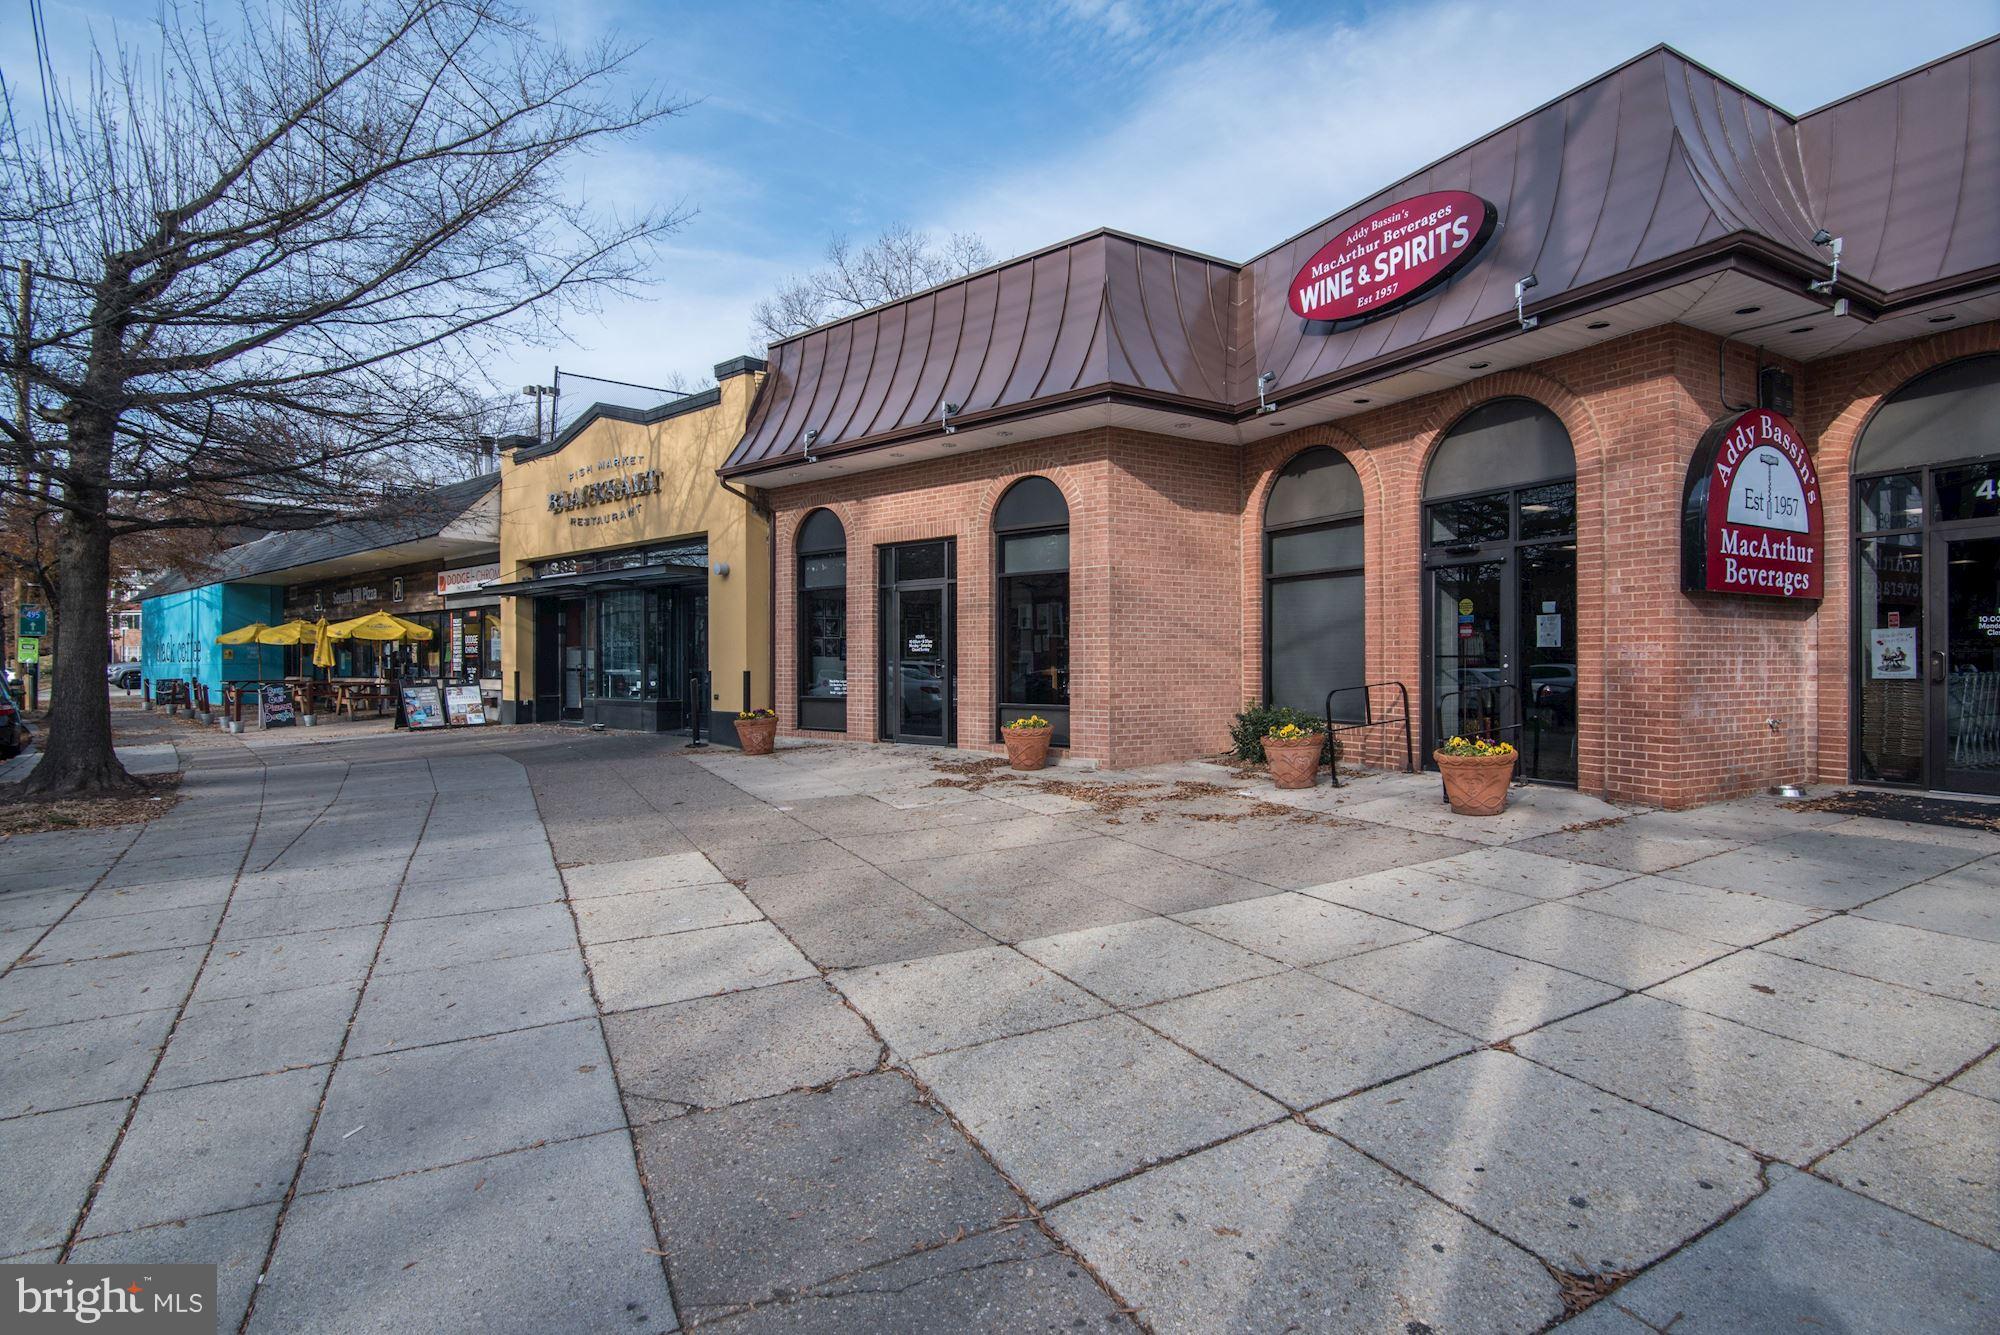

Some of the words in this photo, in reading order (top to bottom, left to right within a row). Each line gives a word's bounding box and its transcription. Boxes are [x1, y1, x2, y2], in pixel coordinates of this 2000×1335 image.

[1311, 239, 1380, 279] MacArthur
[1383, 205, 1452, 244] Beverages
[1346, 226, 1369, 247] Addy
[1371, 209, 1409, 231] Bassin's
[1299, 267, 1353, 314] WINE
[1357, 264, 1371, 286] &
[1374, 215, 1469, 282] SPIRITS
[1357, 296, 1373, 308] Est
[1375, 282, 1399, 301] 1957
[568, 465, 593, 482] FISH
[597, 456, 645, 471] MARKET
[1716, 425, 1756, 488] Addy
[1760, 415, 1817, 505] Bassin's
[1745, 488, 1764, 511] Est
[1774, 496, 1799, 517] 1957
[1976, 479, 2000, 499] 4
[570, 504, 642, 526] RESTAURANT
[1720, 529, 1814, 563] MacArthur
[1725, 558, 1809, 596] Beverages
